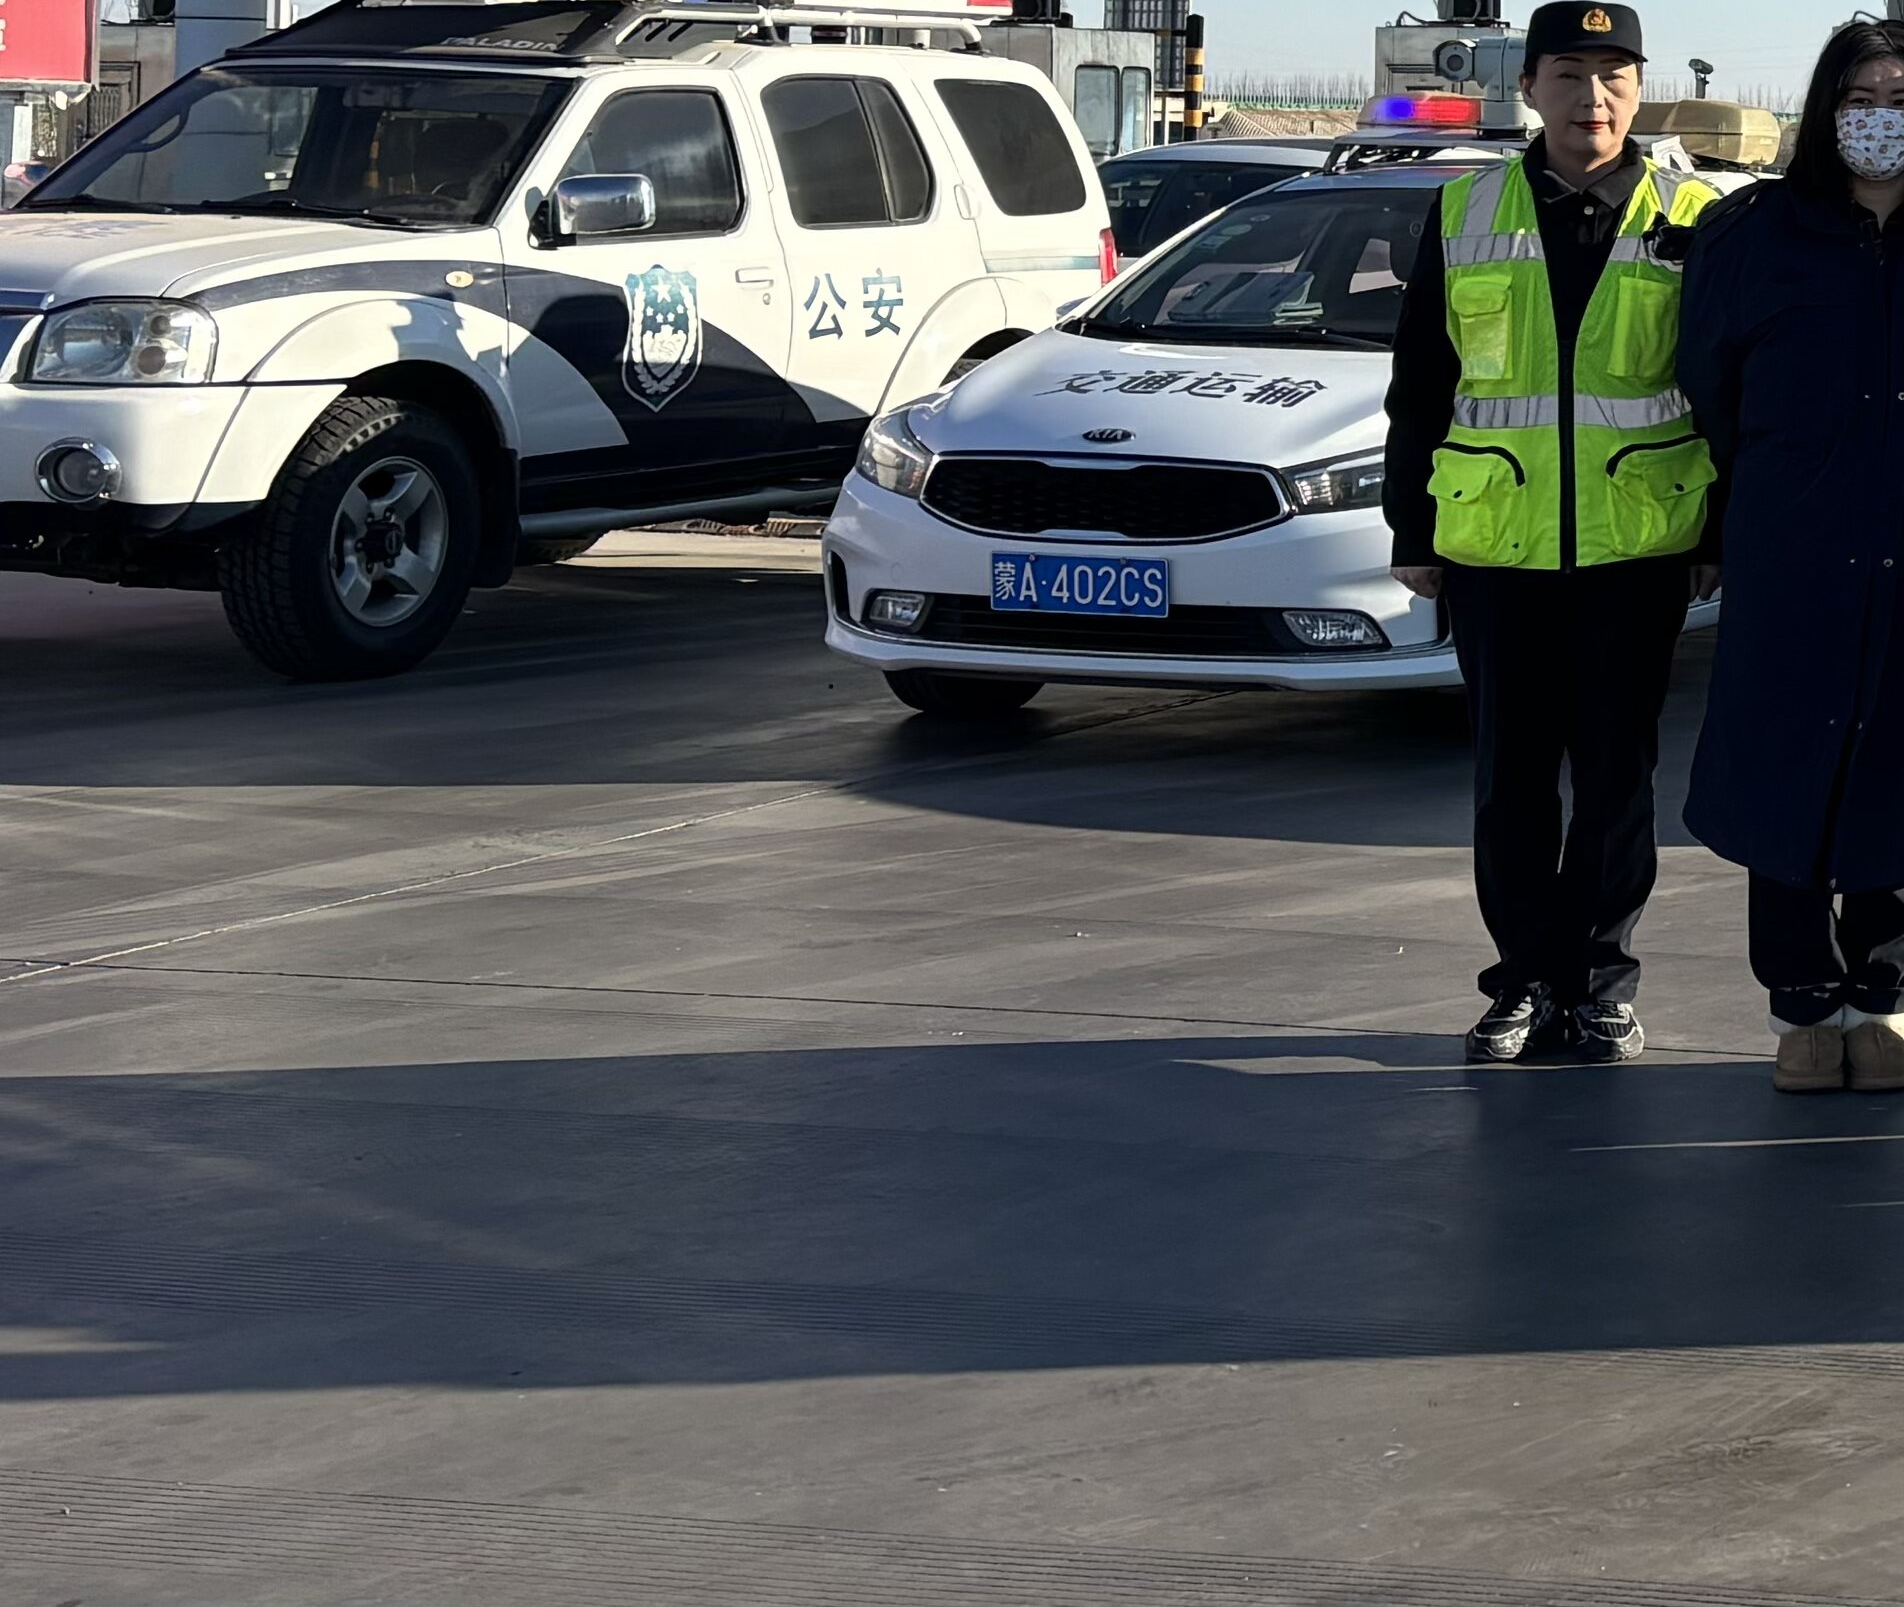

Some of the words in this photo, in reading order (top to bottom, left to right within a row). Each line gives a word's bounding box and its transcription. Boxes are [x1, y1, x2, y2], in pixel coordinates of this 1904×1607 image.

[804, 268, 904, 340] 公安
[1034, 369, 1328, 408] 交通运输
[1087, 429, 1124, 439] KIA
[995, 561, 1163, 608] 蒙A·402CS
